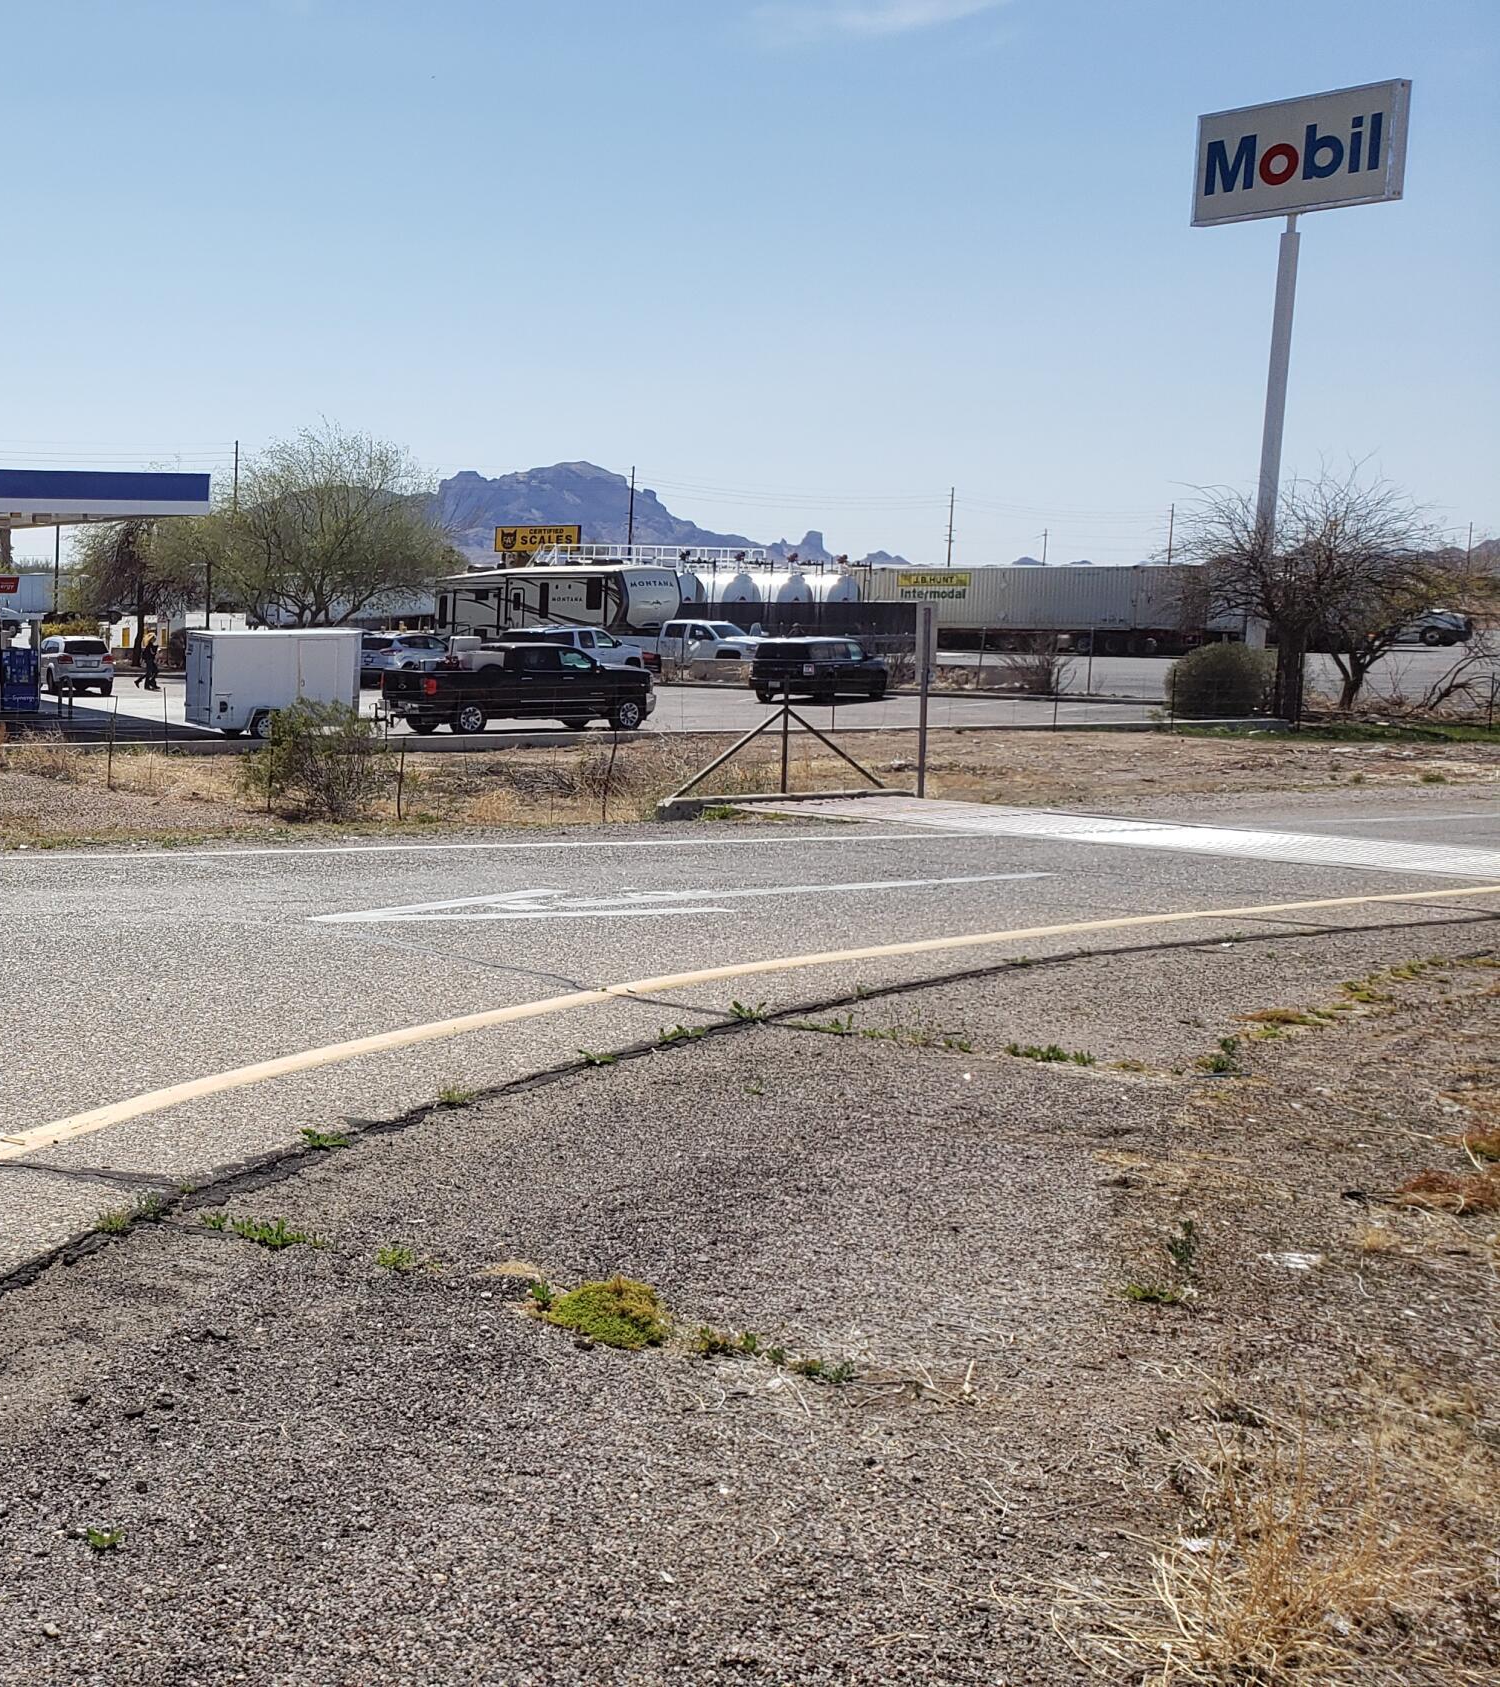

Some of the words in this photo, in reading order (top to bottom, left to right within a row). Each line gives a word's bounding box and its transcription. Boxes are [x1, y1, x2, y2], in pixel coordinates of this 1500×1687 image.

[1203, 111, 1383, 197] Mobil
[520, 534, 573, 545] SCALES
[630, 580, 675, 588] MONTANA
[929, 576, 954, 584] HUNT
[900, 588, 966, 599] Intermodal
